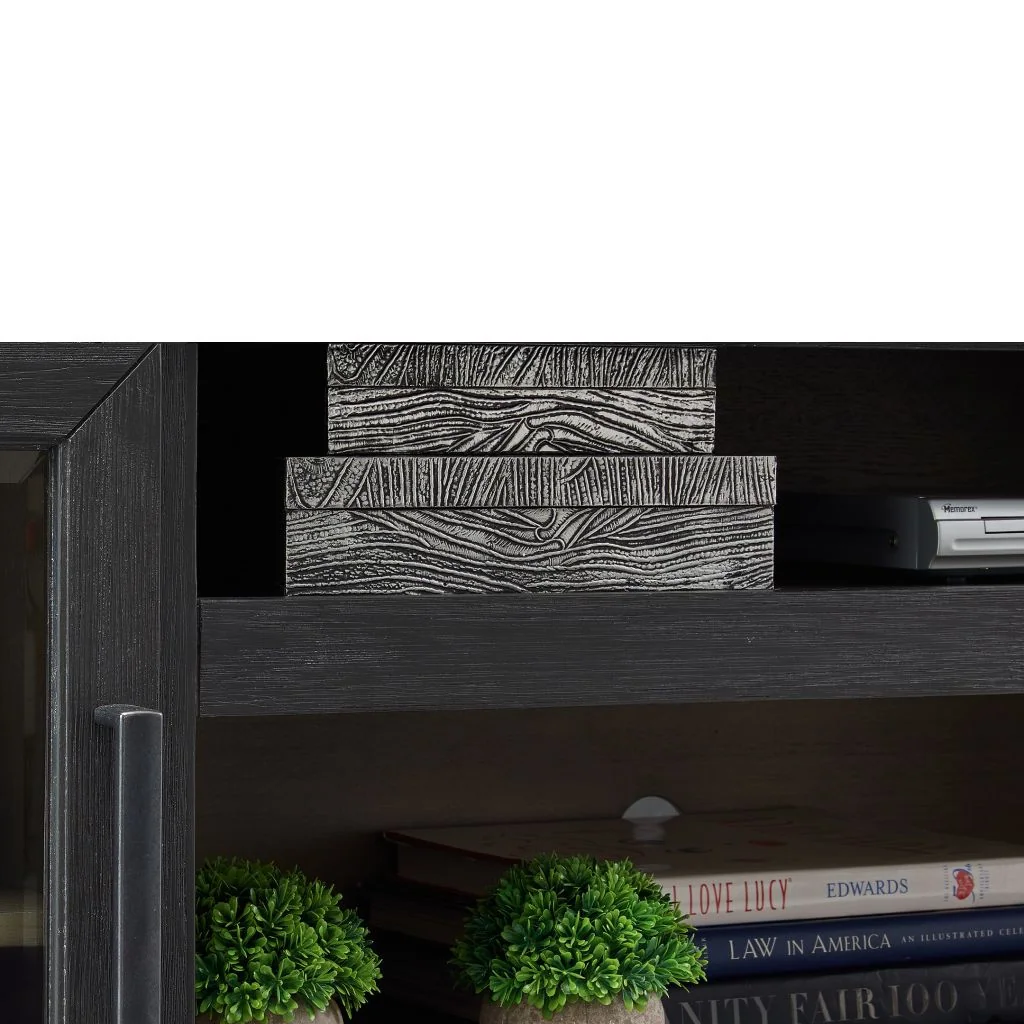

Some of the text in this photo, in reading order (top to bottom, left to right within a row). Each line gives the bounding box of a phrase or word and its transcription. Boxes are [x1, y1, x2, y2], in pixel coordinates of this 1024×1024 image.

[943, 505, 976, 513] Memorex
[689, 882, 733, 915] LOVE
[744, 879, 788, 912] LUCY
[826, 878, 909, 899] EDWARDS
[728, 936, 778, 961] LAW
[786, 939, 804, 956] IN
[811, 932, 891, 954] AMERICA
[901, 935, 915, 944] AN
[921, 929, 994, 943] ILLUSTRATED
